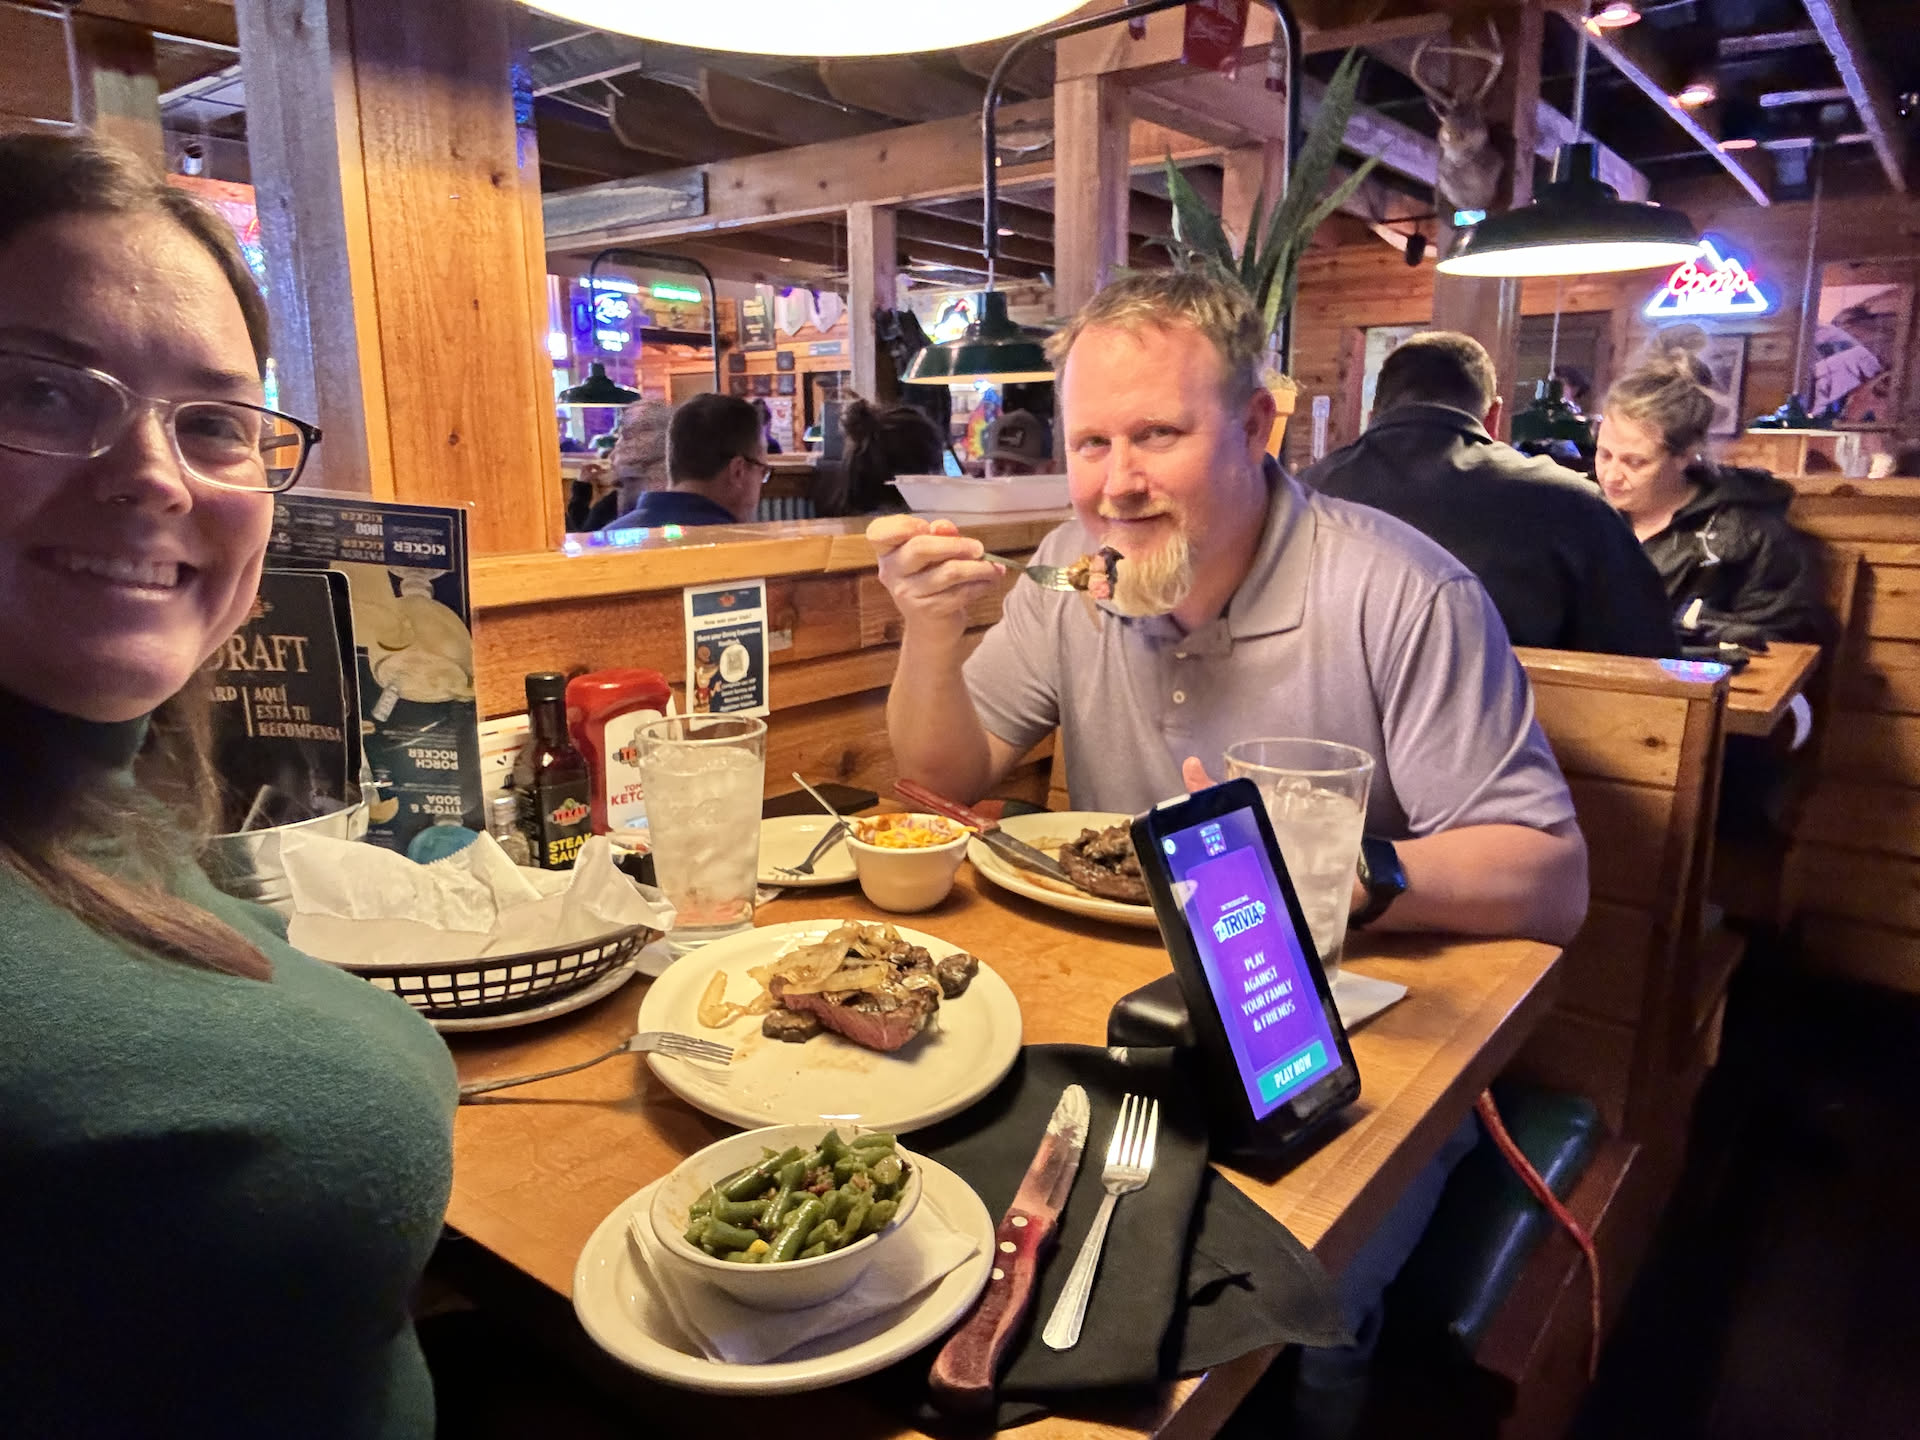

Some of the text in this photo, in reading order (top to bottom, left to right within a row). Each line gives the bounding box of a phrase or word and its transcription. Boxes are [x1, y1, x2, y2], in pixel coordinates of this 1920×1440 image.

[1668, 260, 1749, 296] Coors
[393, 540, 446, 556] KICKER
[408, 749, 458, 760] ROCKER
[415, 759, 459, 770] PORCH
[624, 783, 642, 792] TOM
[426, 795, 461, 805] SODA
[611, 790, 644, 806] KETC
[422, 804, 462, 815] TITO'S
[549, 848, 578, 865] SAU
[1243, 951, 1265, 972] PLAY
[1243, 970, 1278, 995] AGAINST
[1241, 978, 1293, 1016] YOUR FAMILY
[1253, 999, 1296, 1032] & FRIENDS
[1273, 1053, 1312, 1088] PLAY NOW
